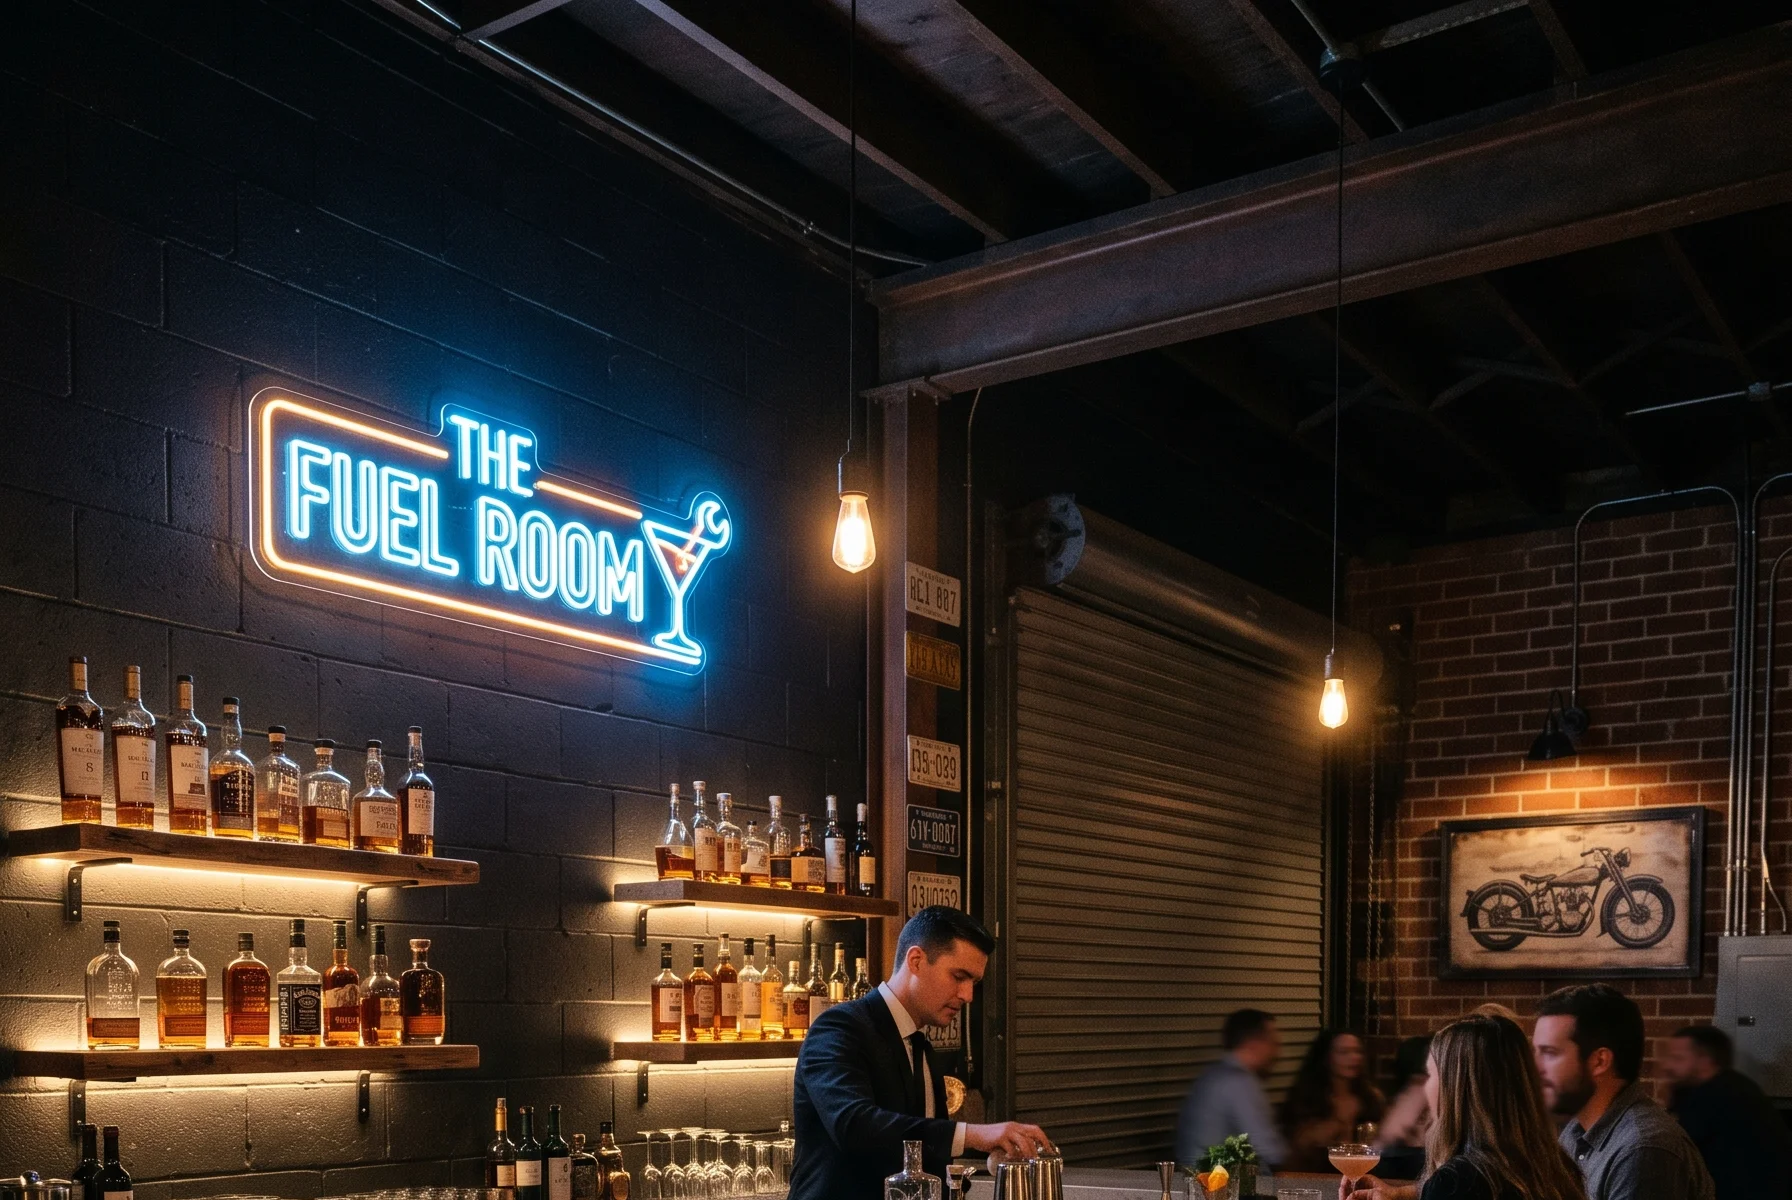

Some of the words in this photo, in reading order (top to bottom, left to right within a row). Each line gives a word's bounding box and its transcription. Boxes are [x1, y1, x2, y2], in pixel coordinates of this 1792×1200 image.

[447, 414, 534, 497] THE
[286, 439, 459, 577] FUEL
[475, 495, 645, 622] ROOM
